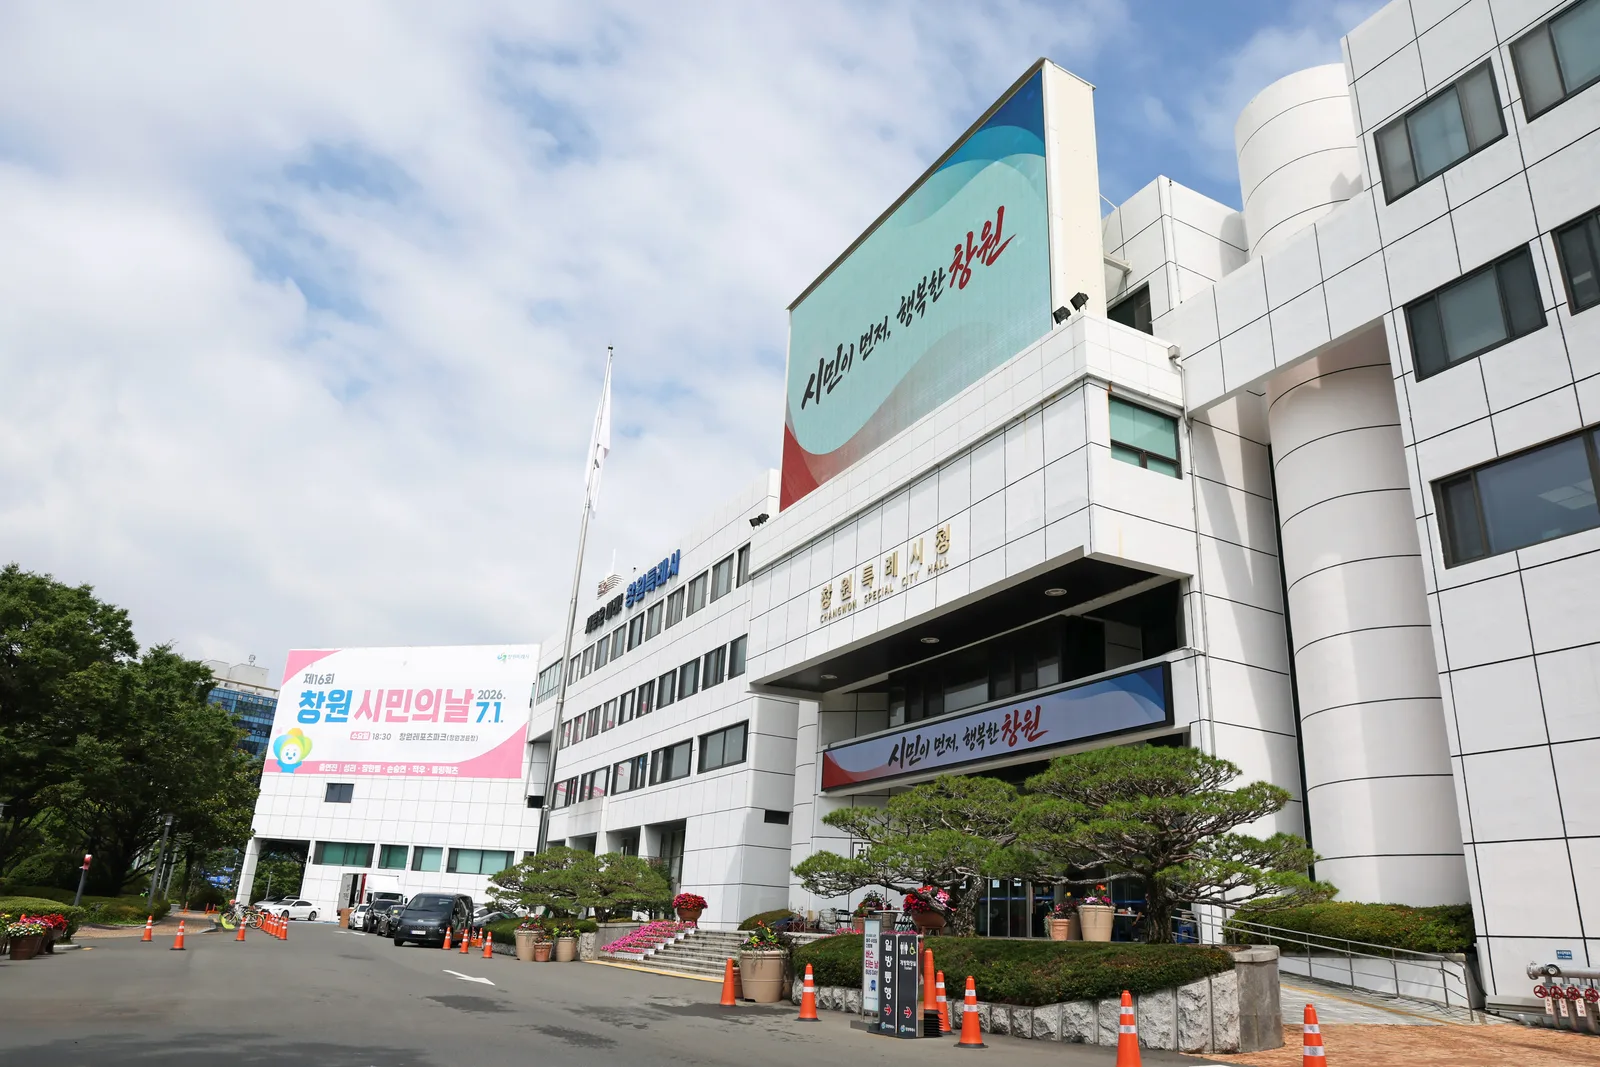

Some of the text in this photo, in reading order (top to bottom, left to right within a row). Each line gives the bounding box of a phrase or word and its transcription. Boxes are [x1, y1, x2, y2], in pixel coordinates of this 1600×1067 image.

[801, 205, 1017, 410] 시민이 먼저, 행복한 창원
[625, 549, 681, 608] 창원특례시
[820, 557, 949, 624] CHANGWON SPECIAL CITY HALL
[303, 673, 335, 685] 제16회
[477, 689, 506, 700] 2026.
[296, 689, 353, 724] 창원
[372, 732, 391, 740] 18:30
[888, 704, 1049, 769] 시민이 먼저, 행복한 창원
